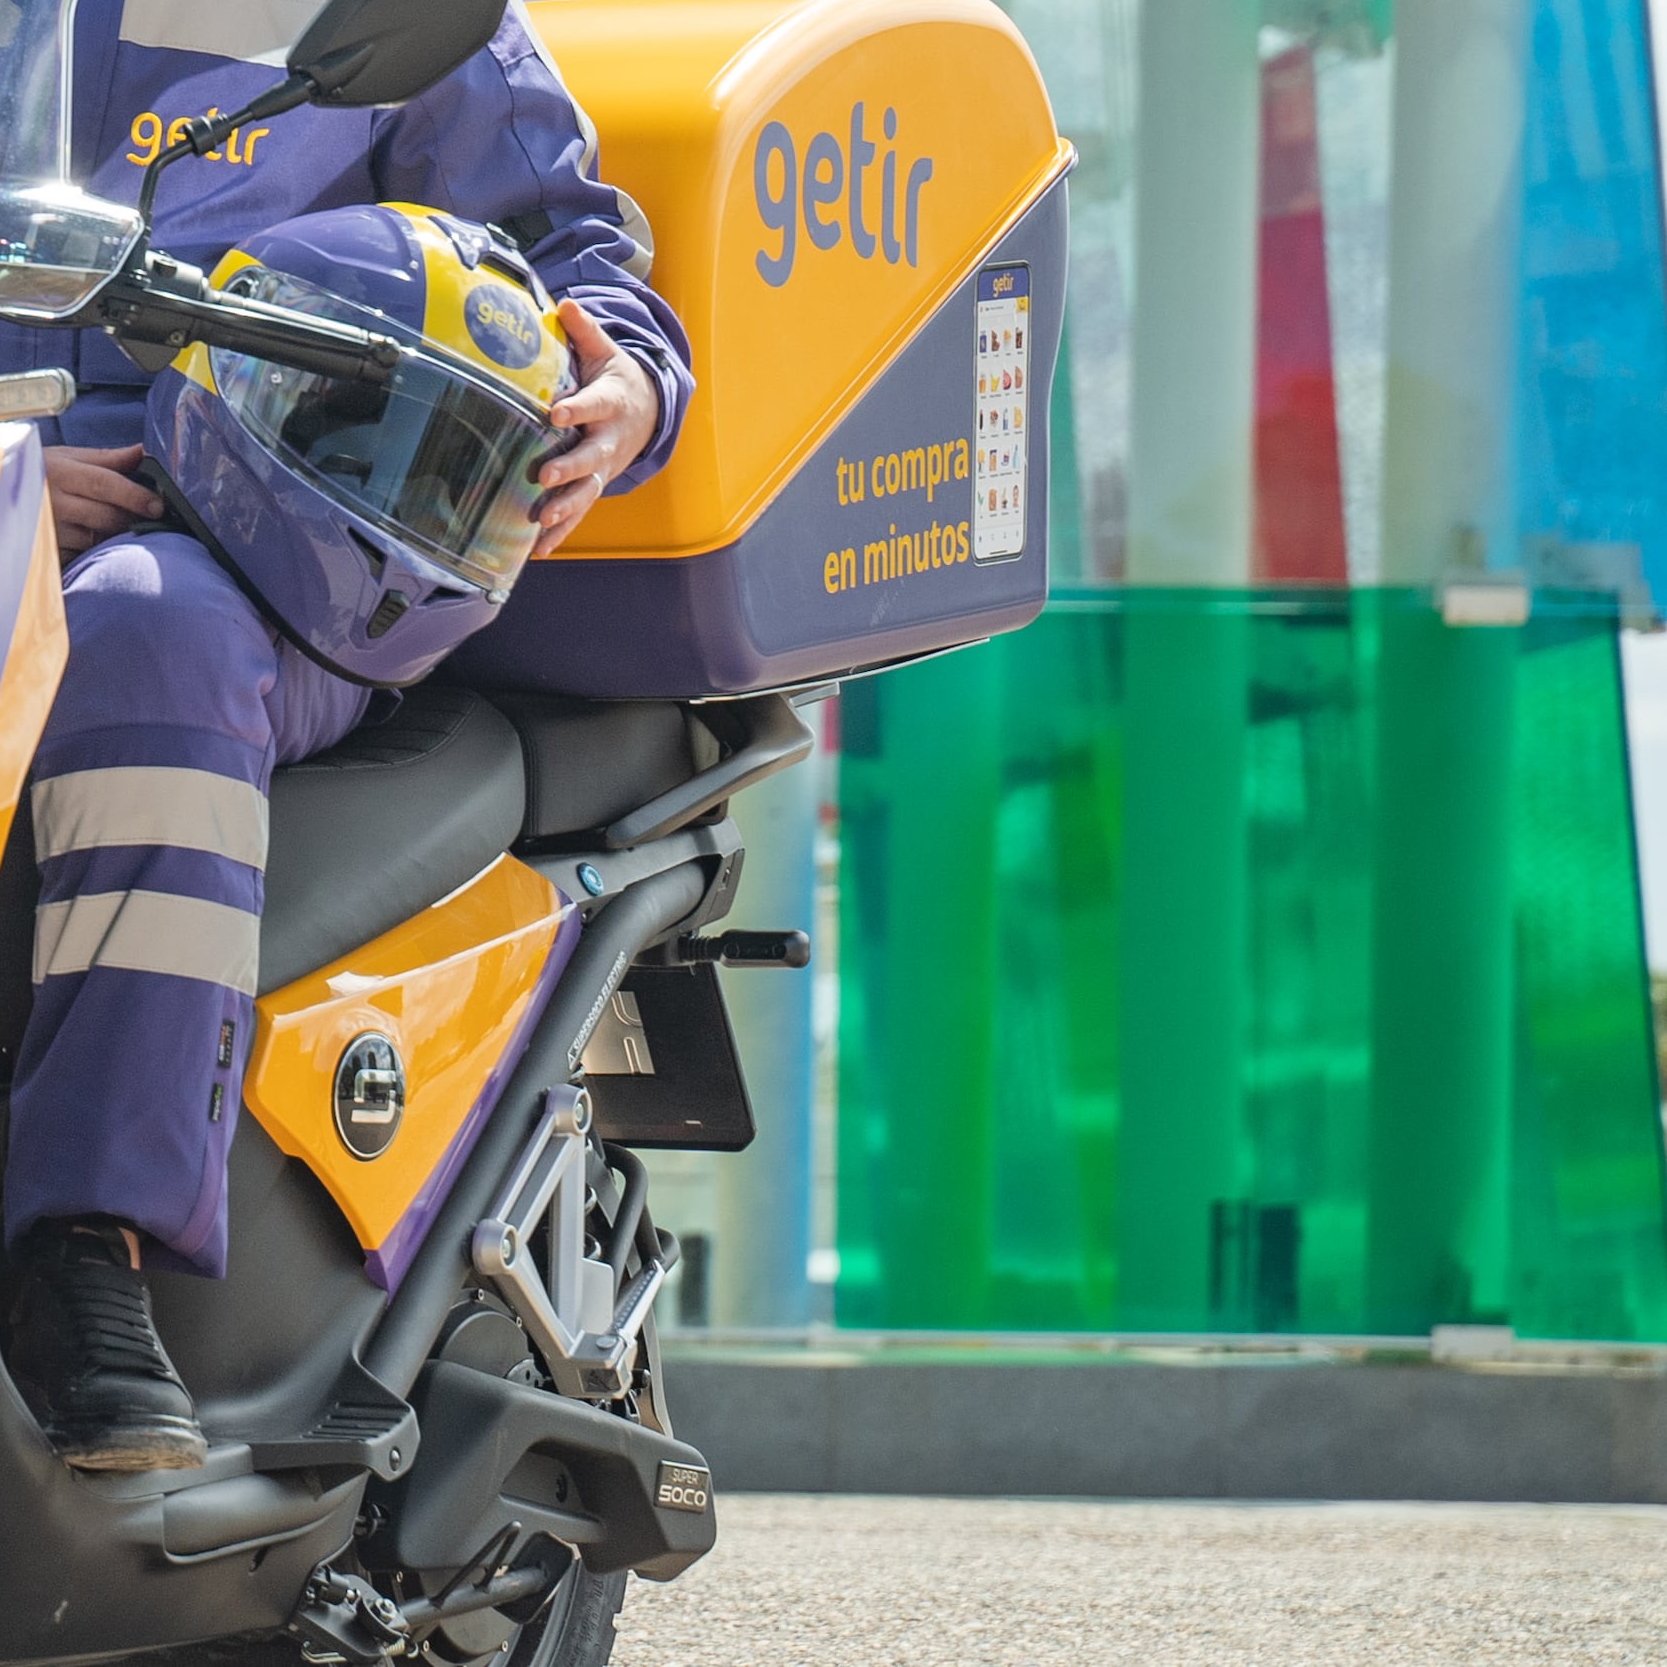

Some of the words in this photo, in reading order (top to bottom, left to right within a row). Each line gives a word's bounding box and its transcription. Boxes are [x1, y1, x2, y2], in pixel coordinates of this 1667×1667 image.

[754, 101, 933, 288] getir
[992, 272, 1015, 298] getir
[476, 302, 533, 345] getir
[835, 455, 867, 506] tu
[871, 437, 969, 504] compra
[823, 544, 858, 594] en
[862, 519, 970, 586] minutos
[658, 1484, 707, 1507] SOCO
[672, 1468, 699, 1485] SUPER
